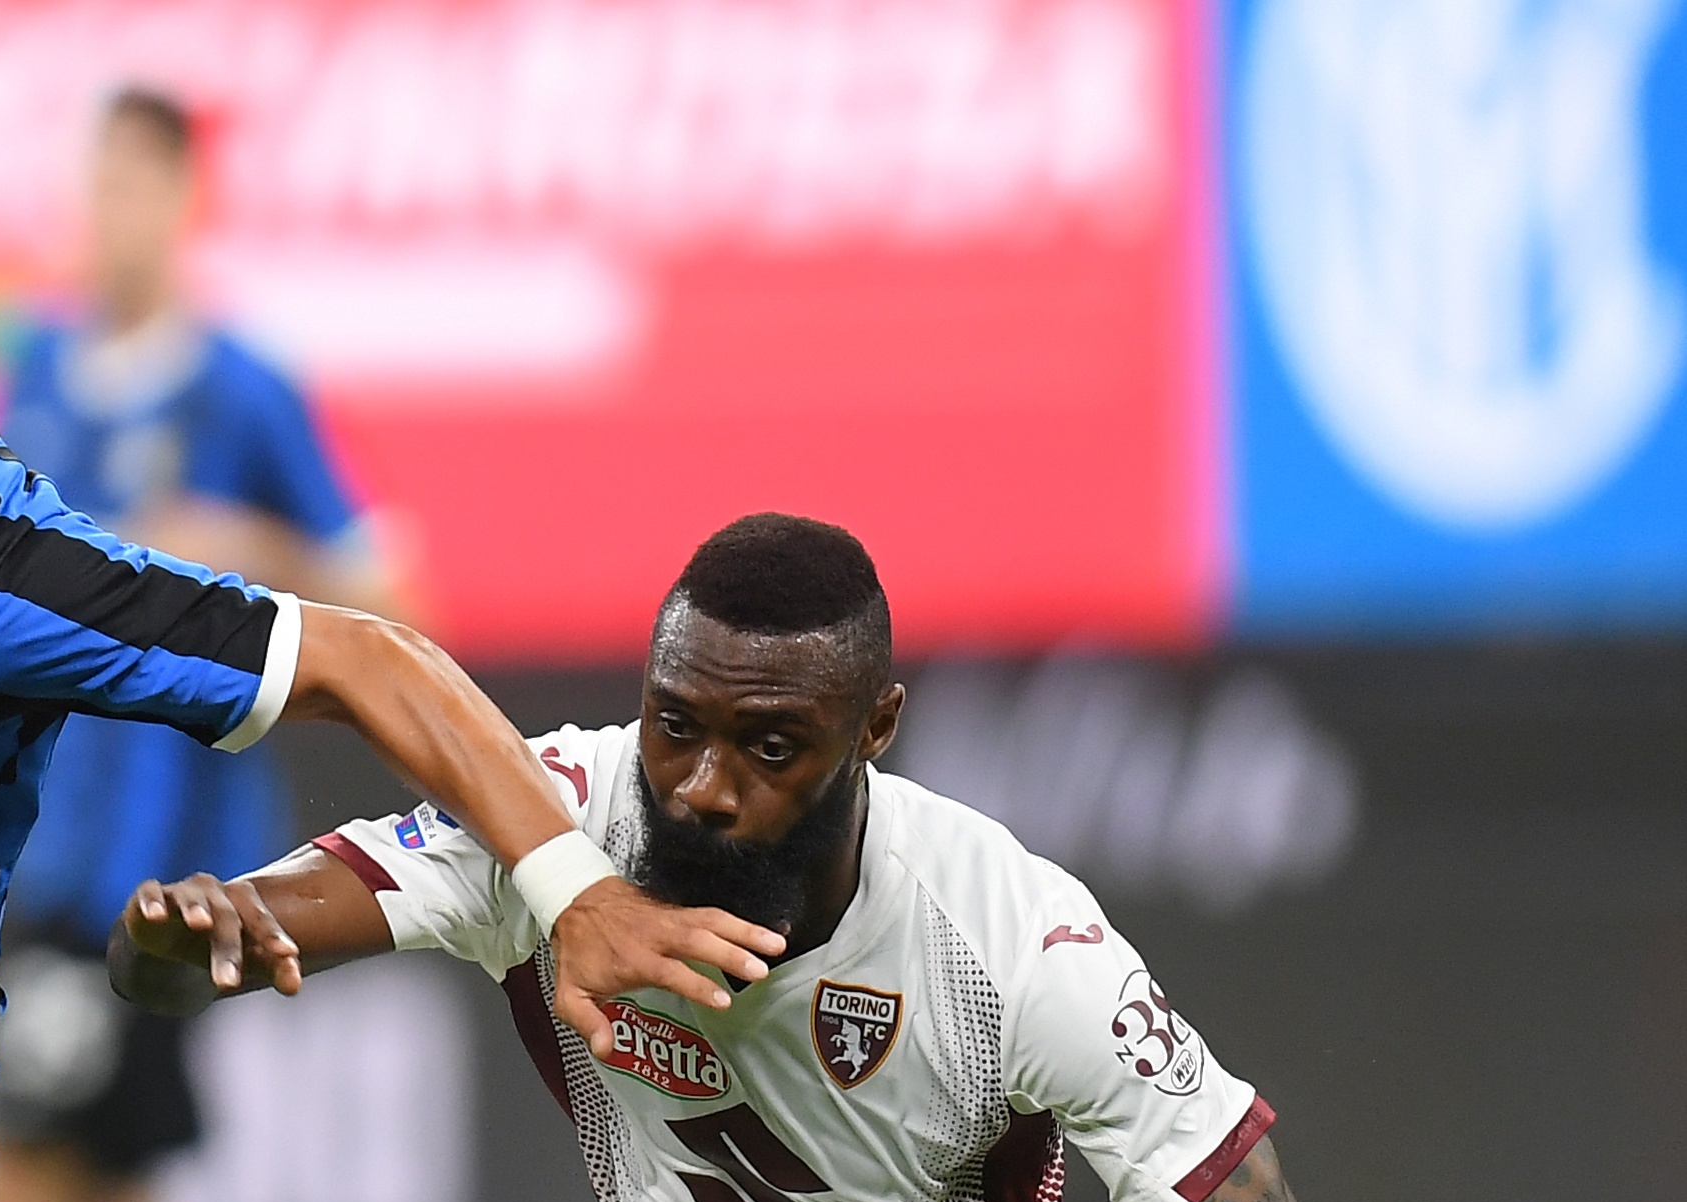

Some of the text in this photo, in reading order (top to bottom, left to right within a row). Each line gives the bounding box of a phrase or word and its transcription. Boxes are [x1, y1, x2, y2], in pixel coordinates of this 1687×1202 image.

[418, 806, 435, 831] SERIE
[826, 992, 891, 1018] TORINO
[615, 1003, 677, 1040] Fratelli
[863, 1022, 888, 1041] FC
[611, 1019, 728, 1092] eretta
[631, 1060, 671, 1089] 1812
